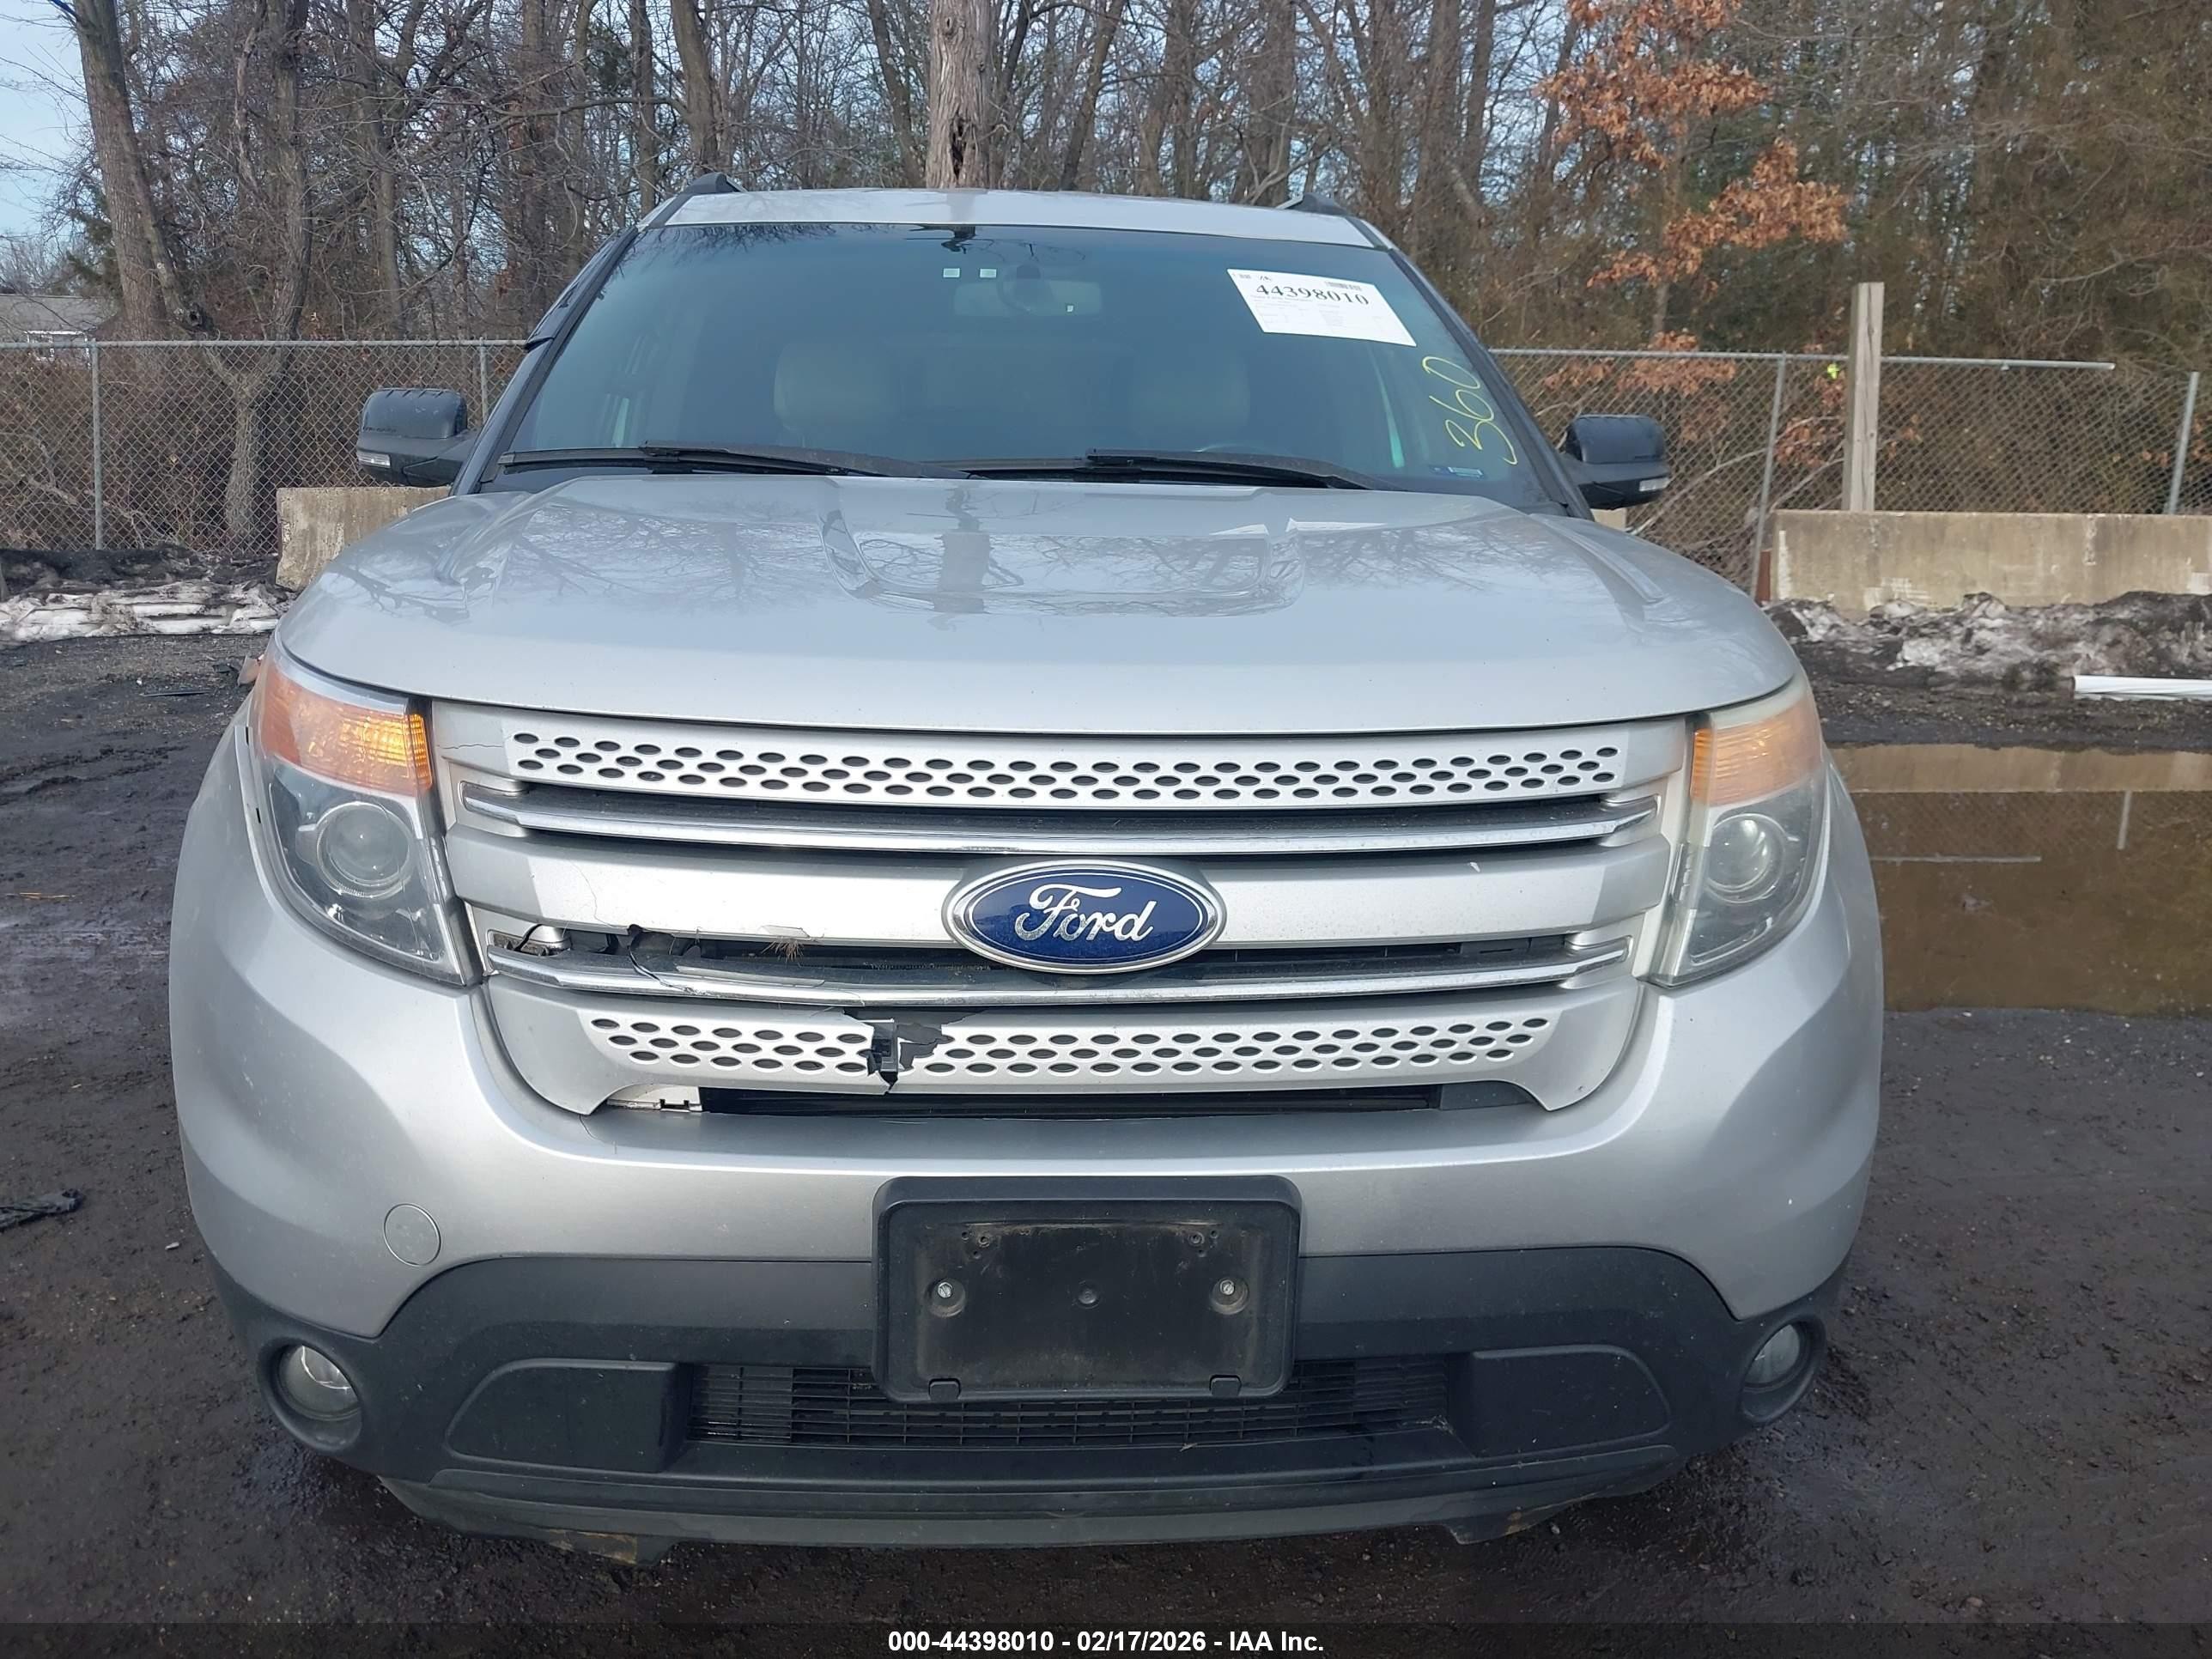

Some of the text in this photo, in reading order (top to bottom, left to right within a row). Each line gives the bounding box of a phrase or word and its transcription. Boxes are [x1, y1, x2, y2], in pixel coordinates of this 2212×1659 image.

[1256, 284, 1370, 305] 44398010
[1422, 356, 1518, 465] 360
[1014, 883, 1157, 942] Ford
